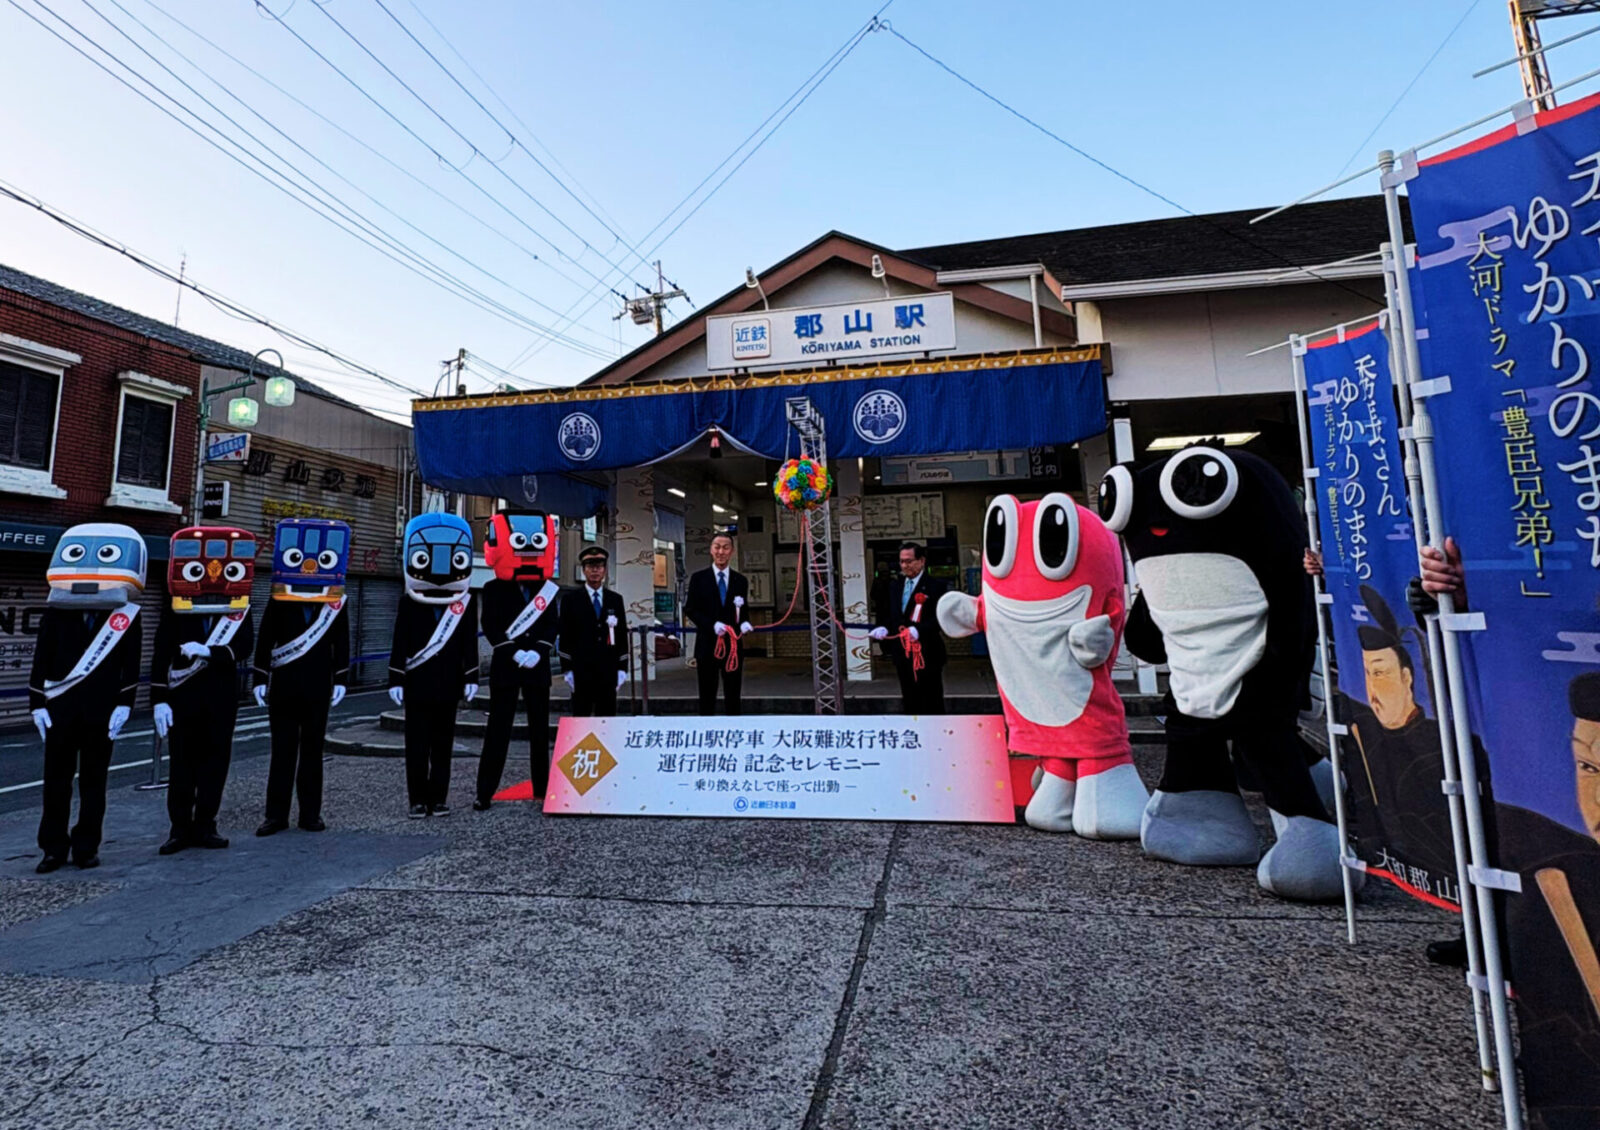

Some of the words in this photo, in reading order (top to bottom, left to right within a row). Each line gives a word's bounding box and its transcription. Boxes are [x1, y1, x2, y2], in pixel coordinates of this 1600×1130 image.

[794, 303, 927, 339] 郡山駅
[735, 325, 767, 342] 近鉄
[869, 334, 921, 348] STATION
[736, 343, 767, 352] KINTETSU
[1332, 376, 1372, 581] ゆかりのまち
[0, 532, 46, 545] FFEE
[111, 615, 128, 629] 祝
[624, 729, 765, 749] 近鉄郡山駅停車
[772, 729, 922, 749] 大阪難波行特急
[570, 748, 601, 779] 祝
[657, 752, 738, 774] 運行開始
[744, 752, 881, 774] 記念セレモニー
